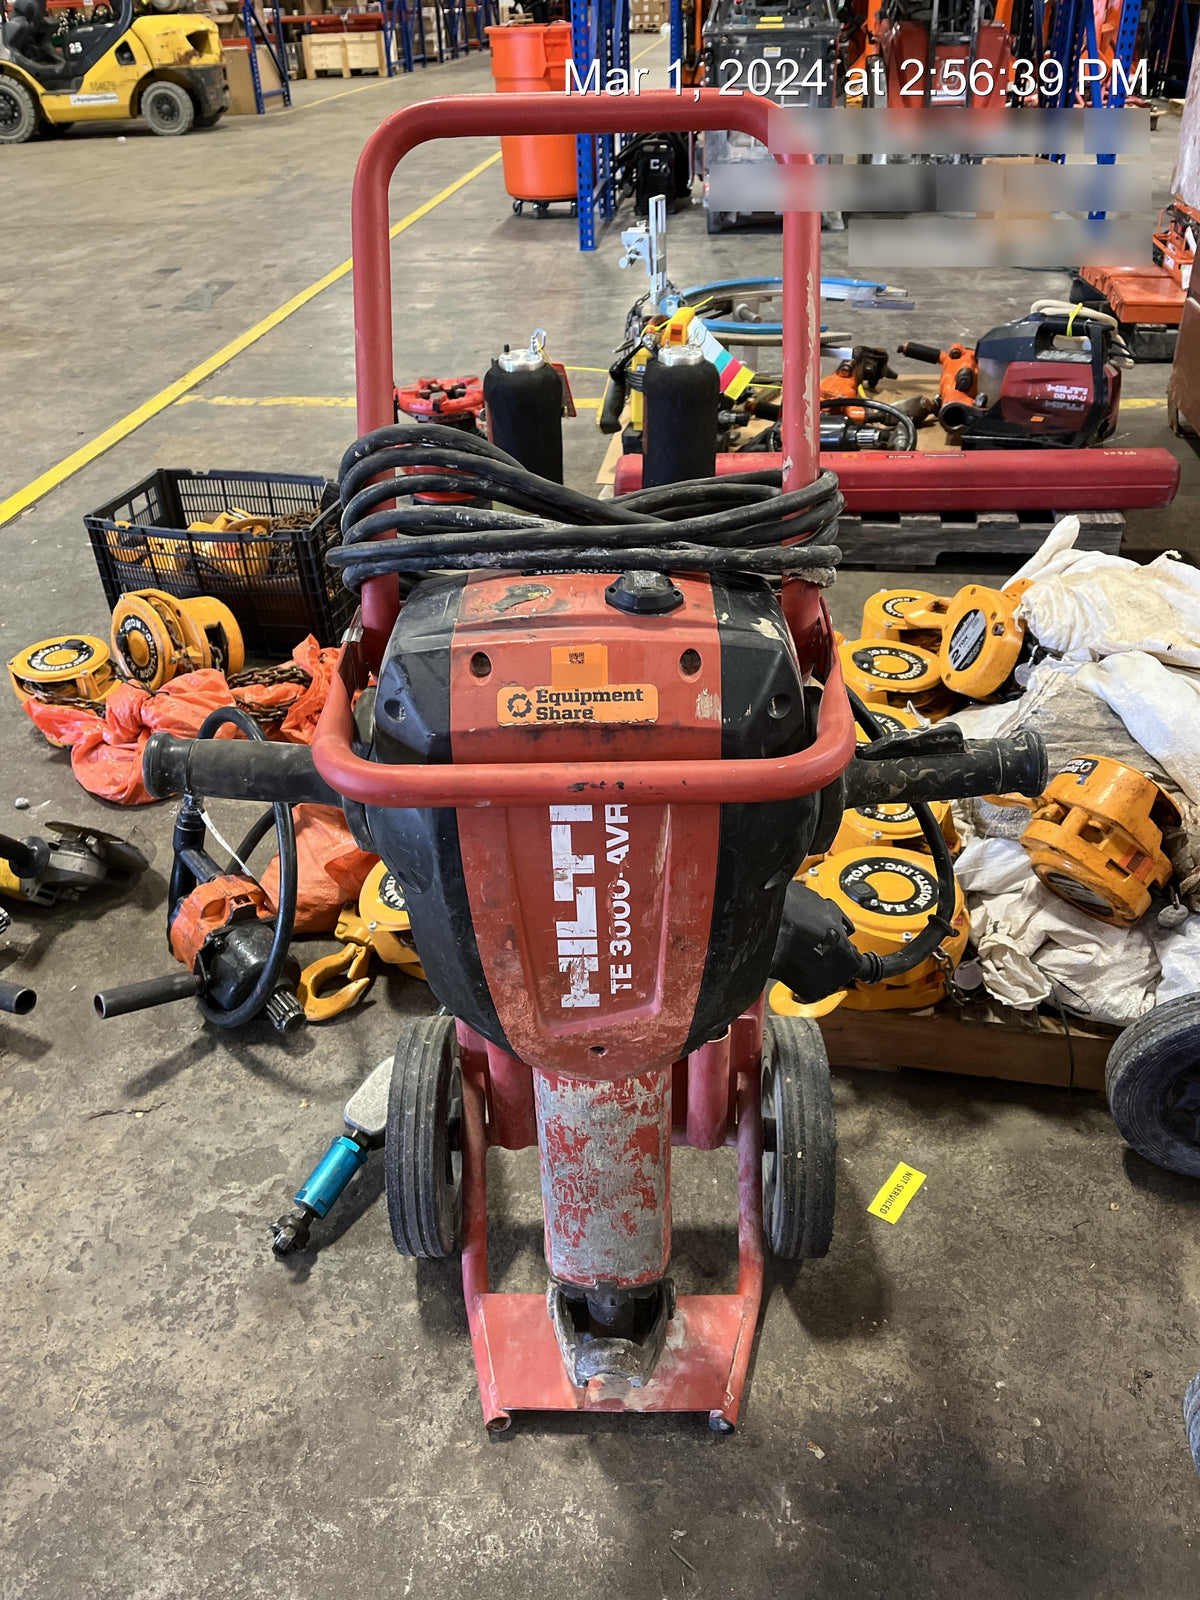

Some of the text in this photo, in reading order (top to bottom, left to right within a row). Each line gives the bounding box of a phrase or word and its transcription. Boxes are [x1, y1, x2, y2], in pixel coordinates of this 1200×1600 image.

[68, 42, 83, 54] 25
[1046, 384, 1088, 395] HILTI
[951, 648, 961, 665] 2
[536, 688, 644, 706] Equipment
[536, 706, 594, 721] Share
[549, 804, 600, 1008] HILTI
[610, 963, 633, 995] TE
[879, 1171, 913, 1214] NOT SERVICED
